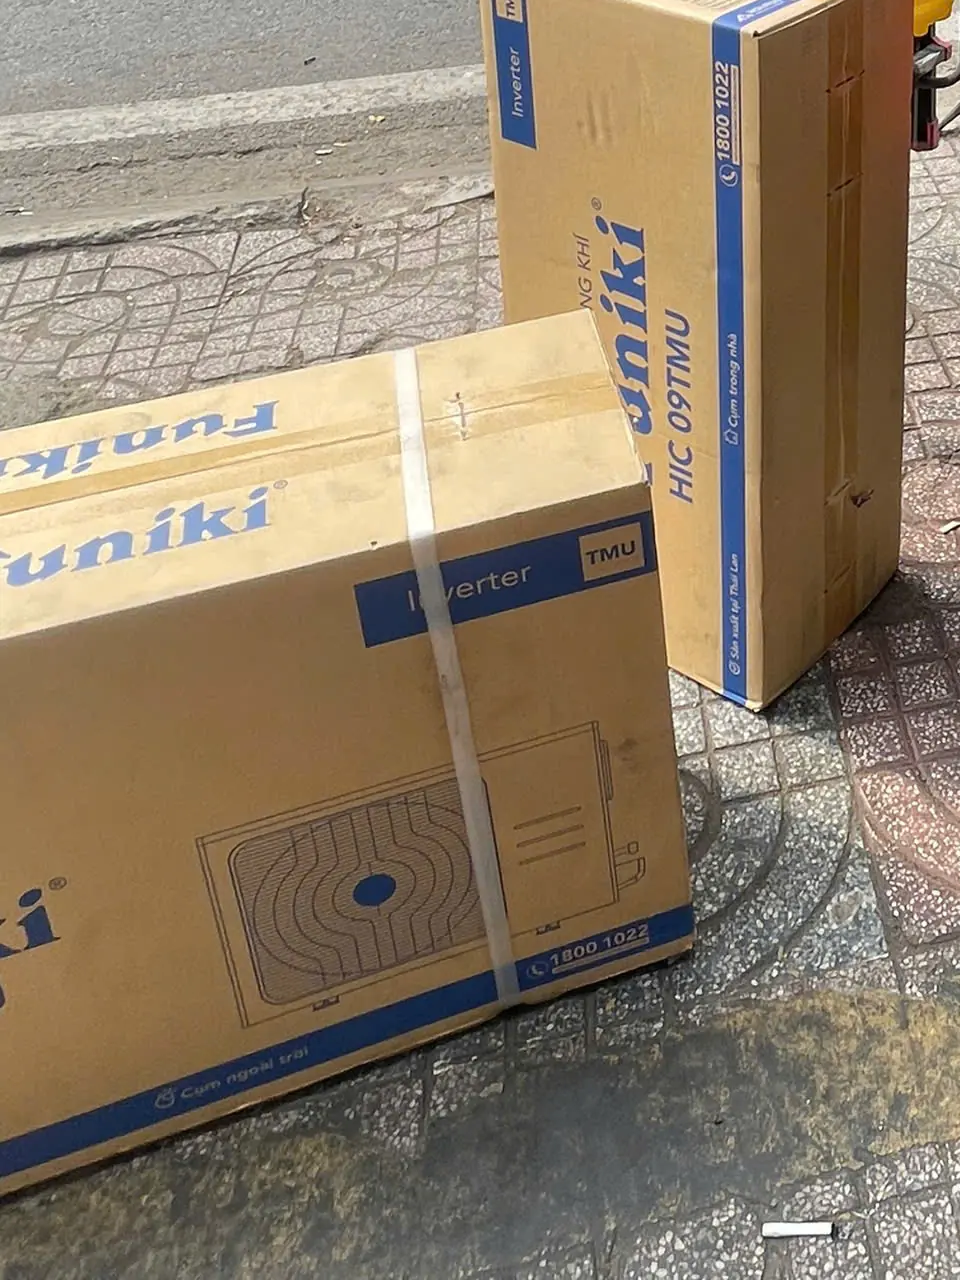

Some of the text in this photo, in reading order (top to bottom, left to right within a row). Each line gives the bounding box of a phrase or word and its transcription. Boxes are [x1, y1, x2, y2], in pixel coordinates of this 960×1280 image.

[510, 47, 524, 117] Inverter
[714, 61, 731, 161] 1800 1022
[596, 215, 652, 485] uniki
[729, 360, 741, 396] trong
[665, 308, 694, 504] HIC 09TMU
[728, 399, 741, 428] Cụm
[0, 487, 272, 587] uniki
[585, 540, 637, 566] TMU
[730, 553, 739, 573] Lan
[407, 565, 532, 612] Iverter
[550, 923, 649, 967] 1800 1022
